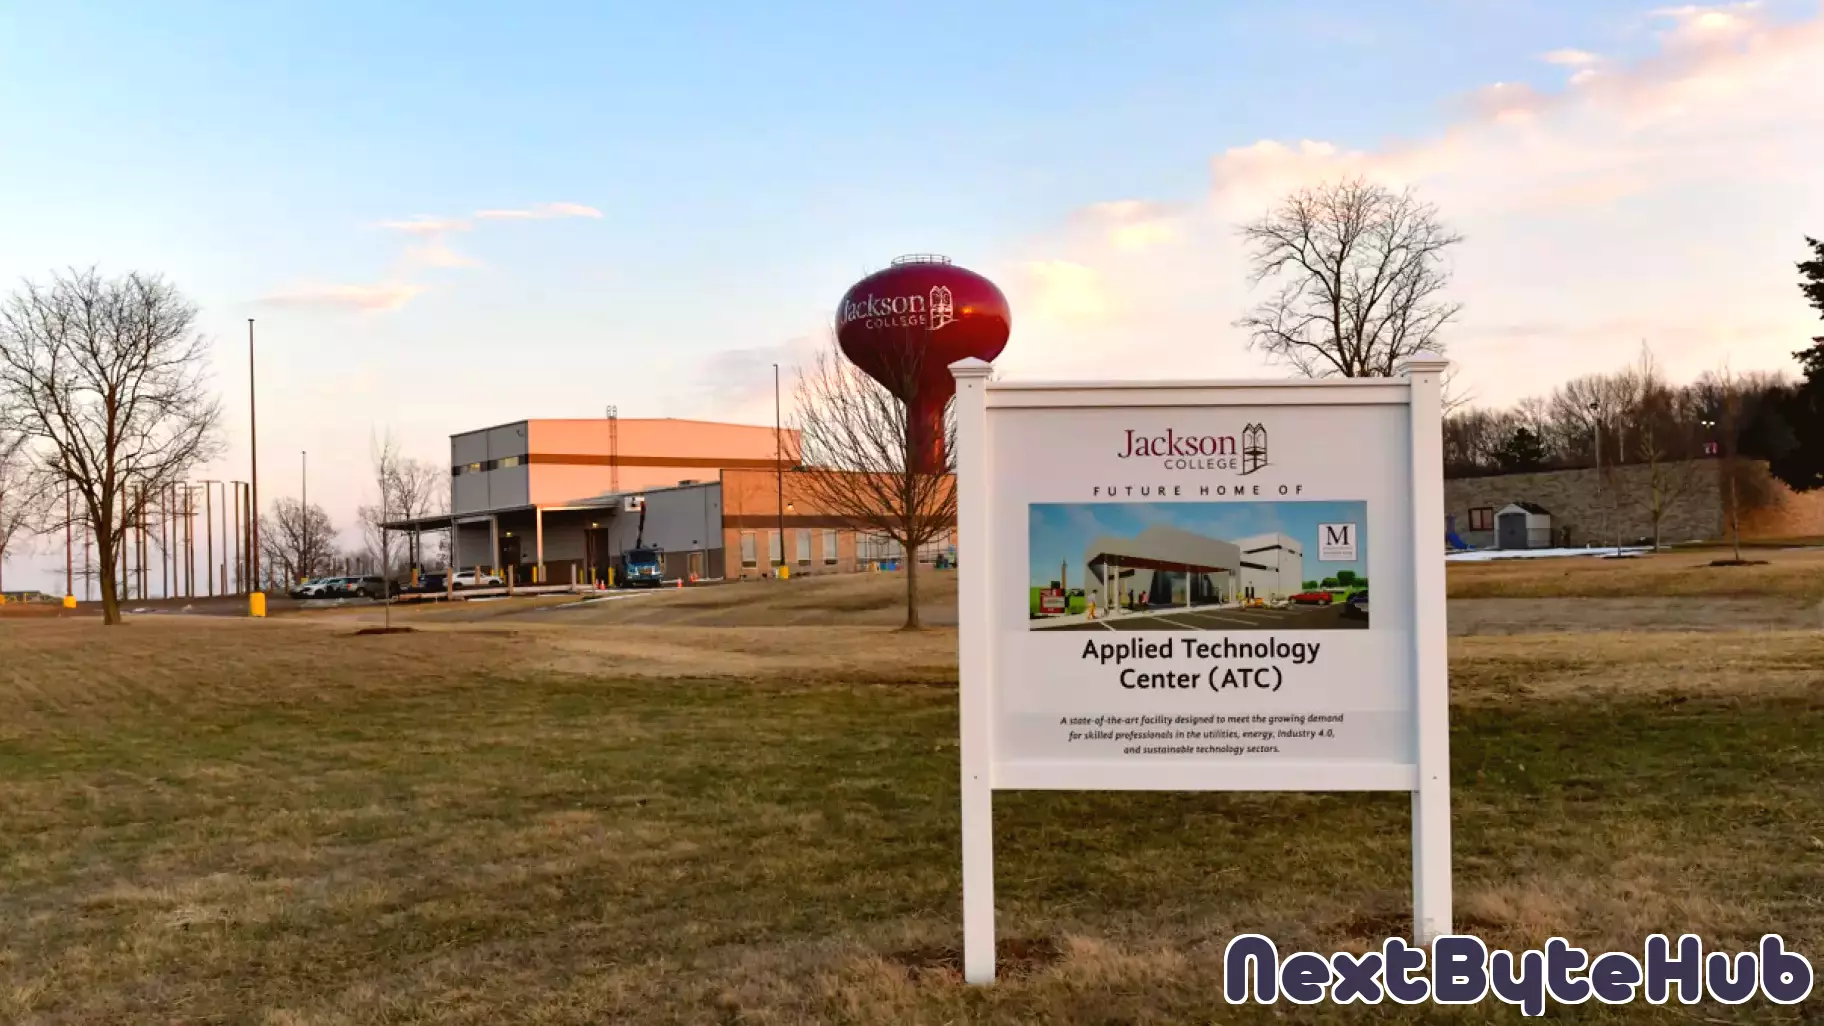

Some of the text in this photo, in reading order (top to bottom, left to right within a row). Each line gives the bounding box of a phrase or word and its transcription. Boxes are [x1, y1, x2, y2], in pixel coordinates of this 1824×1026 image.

[841, 293, 926, 324] Jackson
[866, 313, 927, 329] COLLEGE
[1117, 428, 1237, 458] Jackson
[1164, 459, 1237, 470] COLLEGE
[1093, 485, 1303, 496] FUTURE HOME OF
[1326, 526, 1350, 546] M
[1082, 637, 1320, 664] Applied Technology
[1120, 666, 1283, 692] Center (ATC)
[1060, 713, 1344, 726] A state-of-the-art facility designed to meet the growing demand
[1068, 731, 1083, 742] for
[1085, 731, 1113, 740] skilled
[1115, 731, 1173, 741] professionals
[1175, 731, 1185, 739] in
[1187, 730, 1201, 739] the
[1203, 730, 1240, 740] utilities,
[1242, 731, 1276, 740] energy,
[1318, 729, 1335, 739] 4.0,
[1123, 744, 1280, 755] and sustainable technology sectors.
